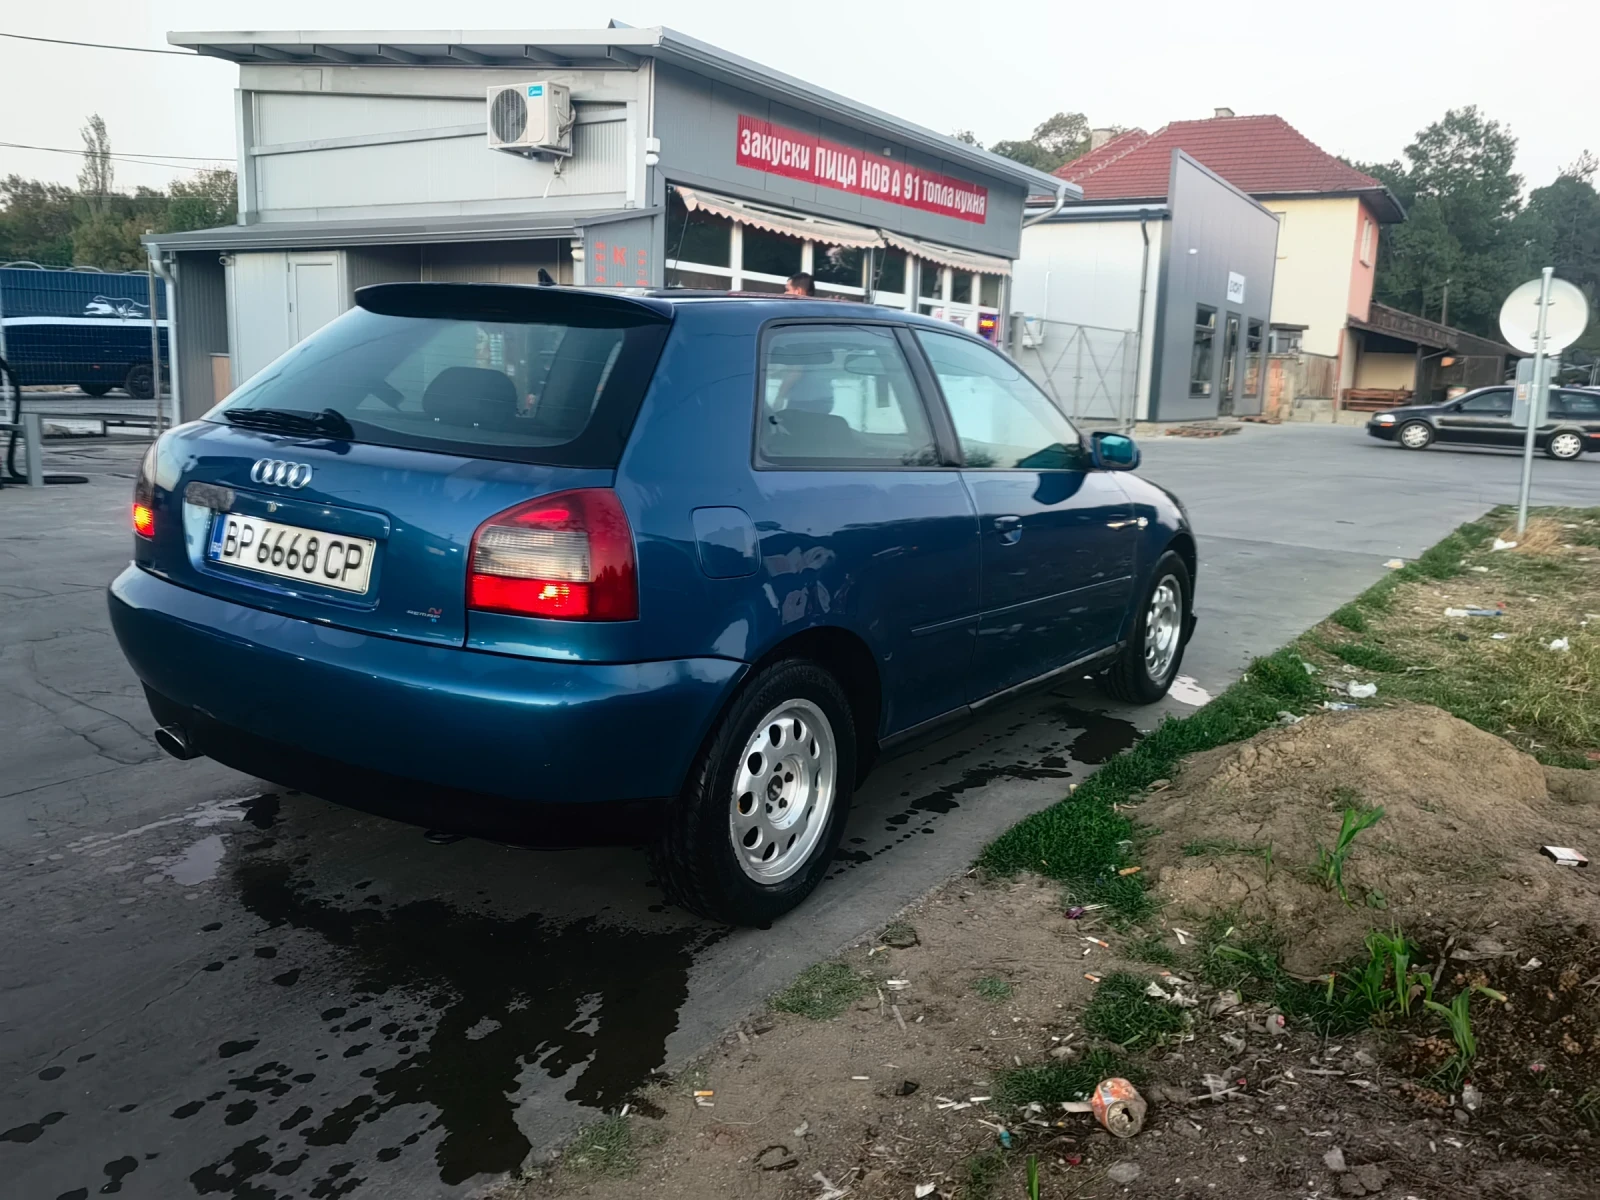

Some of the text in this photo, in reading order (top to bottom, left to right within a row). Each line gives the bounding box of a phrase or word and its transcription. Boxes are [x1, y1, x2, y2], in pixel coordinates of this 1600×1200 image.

[814, 146, 857, 189] ПИЦА
[904, 172, 920, 201] 91
[922, 179, 954, 208] топла
[954, 188, 986, 216] кухня
[256, 527, 320, 575] 6668
